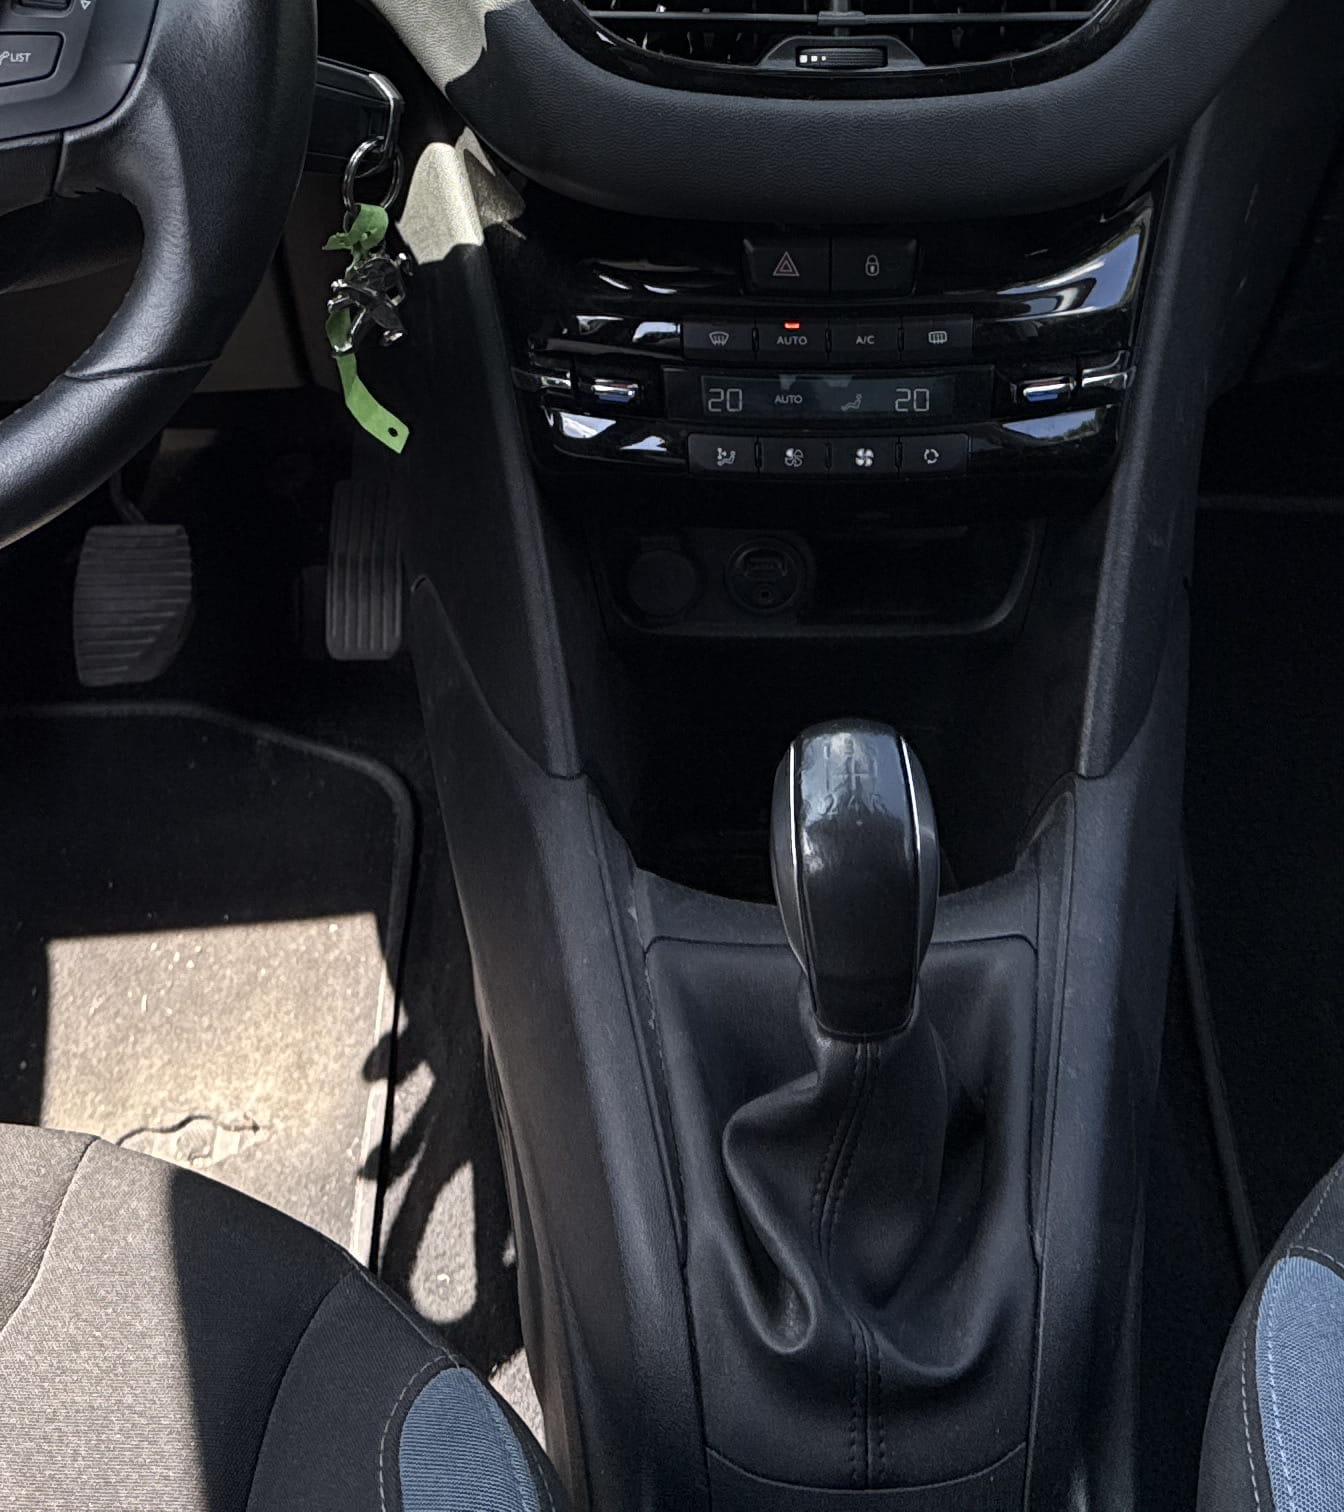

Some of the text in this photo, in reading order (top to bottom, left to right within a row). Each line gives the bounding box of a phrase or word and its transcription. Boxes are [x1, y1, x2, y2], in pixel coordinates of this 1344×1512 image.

[10, 52, 32, 63] LIST
[776, 335, 808, 346] AUTO
[855, 334, 875, 345] A/C
[707, 387, 743, 413] 20
[774, 394, 803, 405] AUTO
[894, 387, 930, 413] 20
